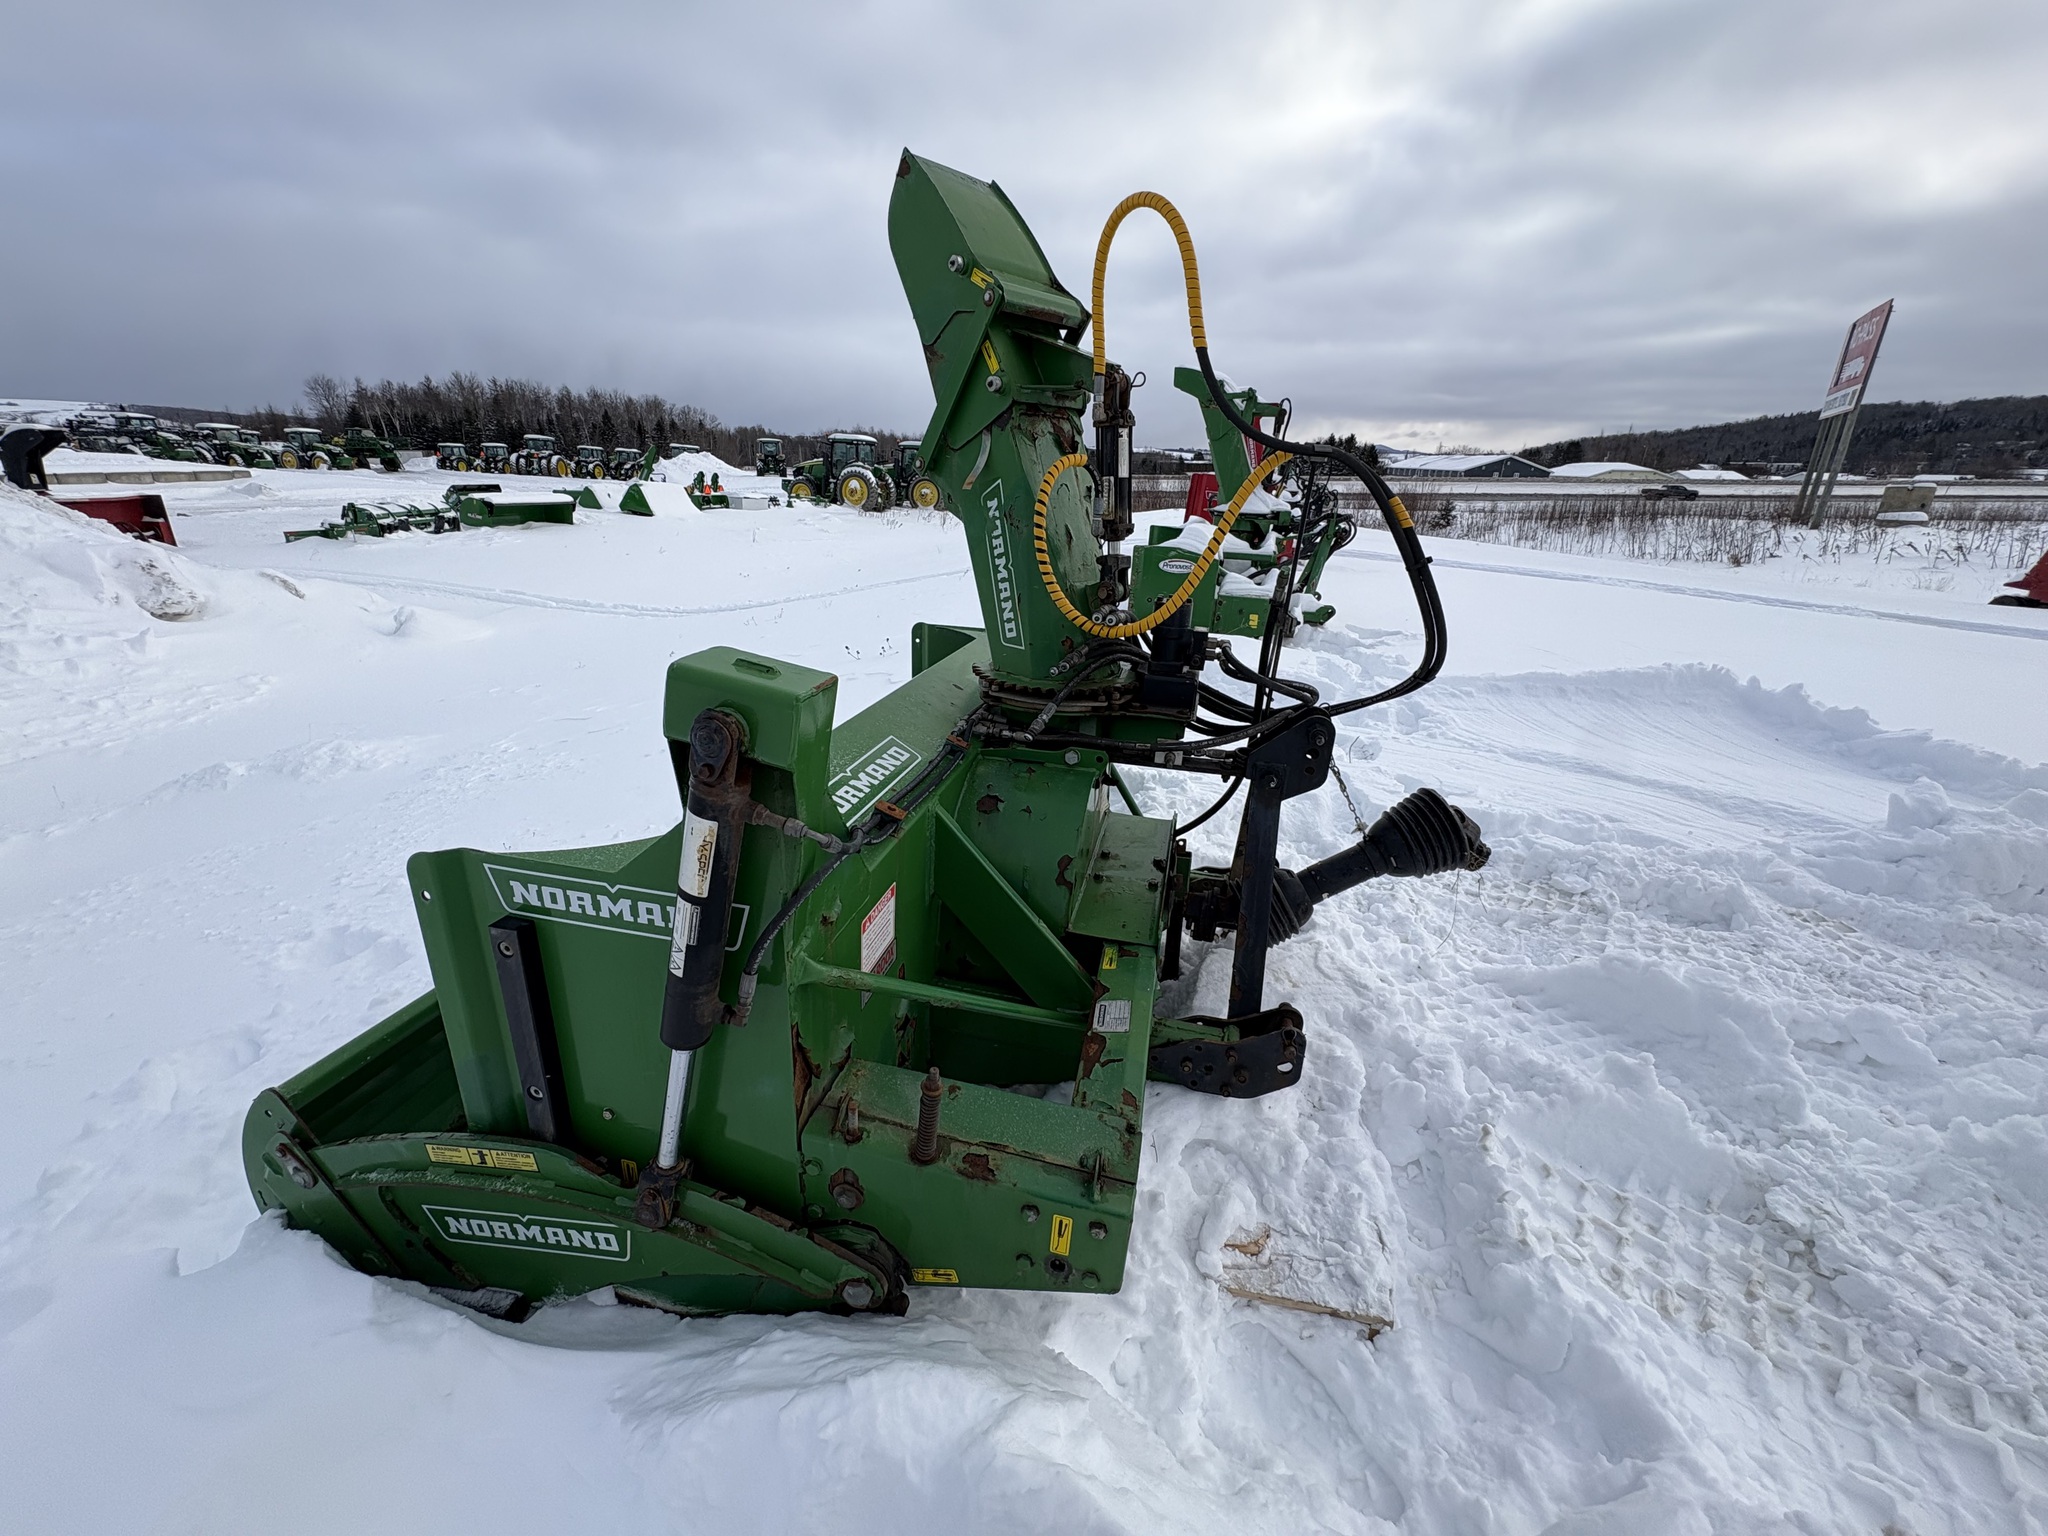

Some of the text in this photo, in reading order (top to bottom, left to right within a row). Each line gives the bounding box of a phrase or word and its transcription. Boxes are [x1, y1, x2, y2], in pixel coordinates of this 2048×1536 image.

[509, 880, 675, 929] NORMA
[871, 890, 892, 921] DANGER
[500, 1151, 531, 1159] ATTENTION
[444, 1216, 620, 1252] NORMAND
